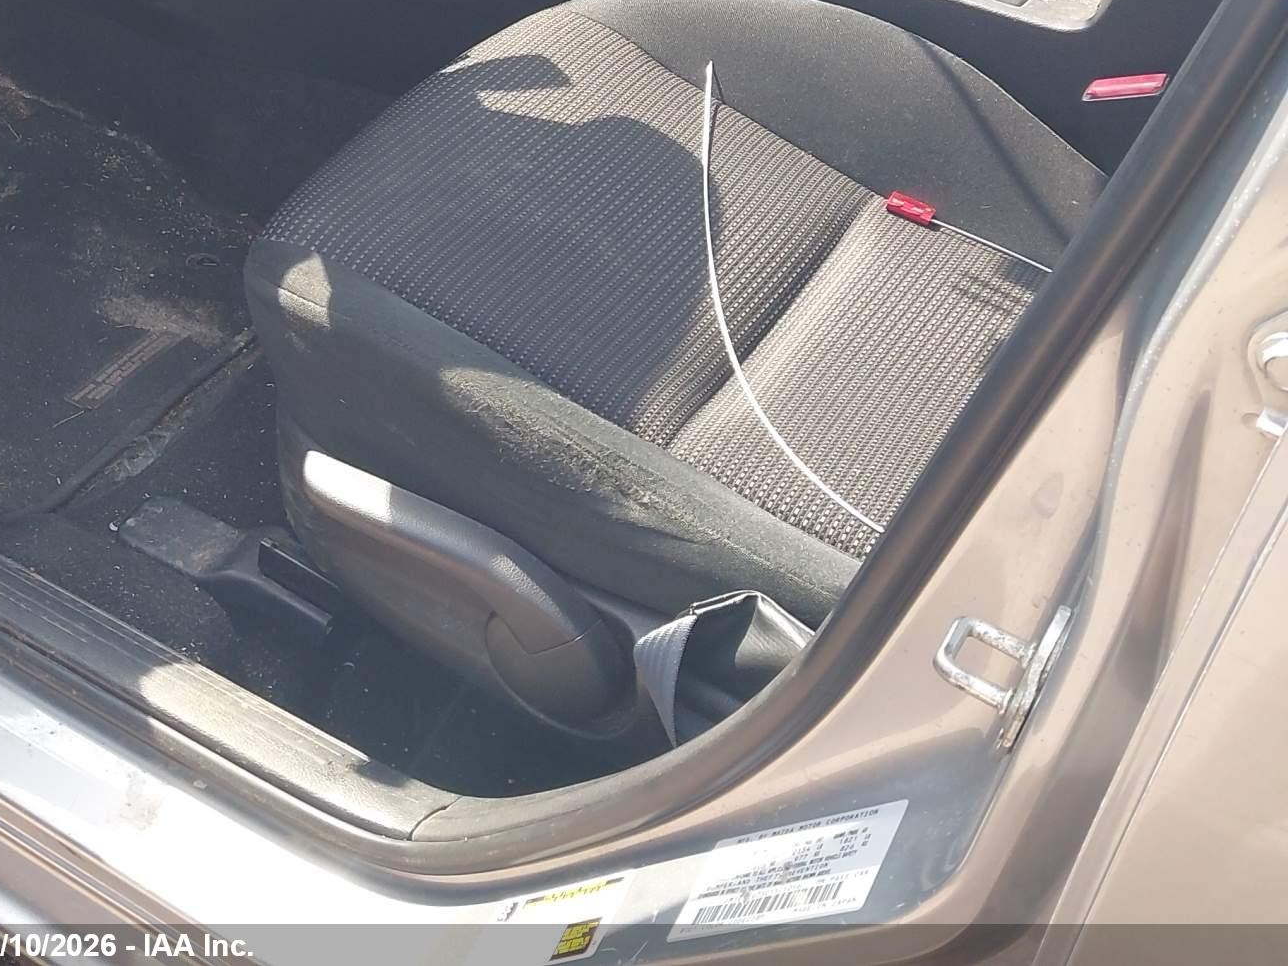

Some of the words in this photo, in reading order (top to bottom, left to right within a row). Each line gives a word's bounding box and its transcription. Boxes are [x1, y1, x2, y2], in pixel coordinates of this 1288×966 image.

[771, 827, 794, 837] MAZDA
[798, 821, 822, 831] MOTOR
[825, 808, 880, 826] CORPORATION
